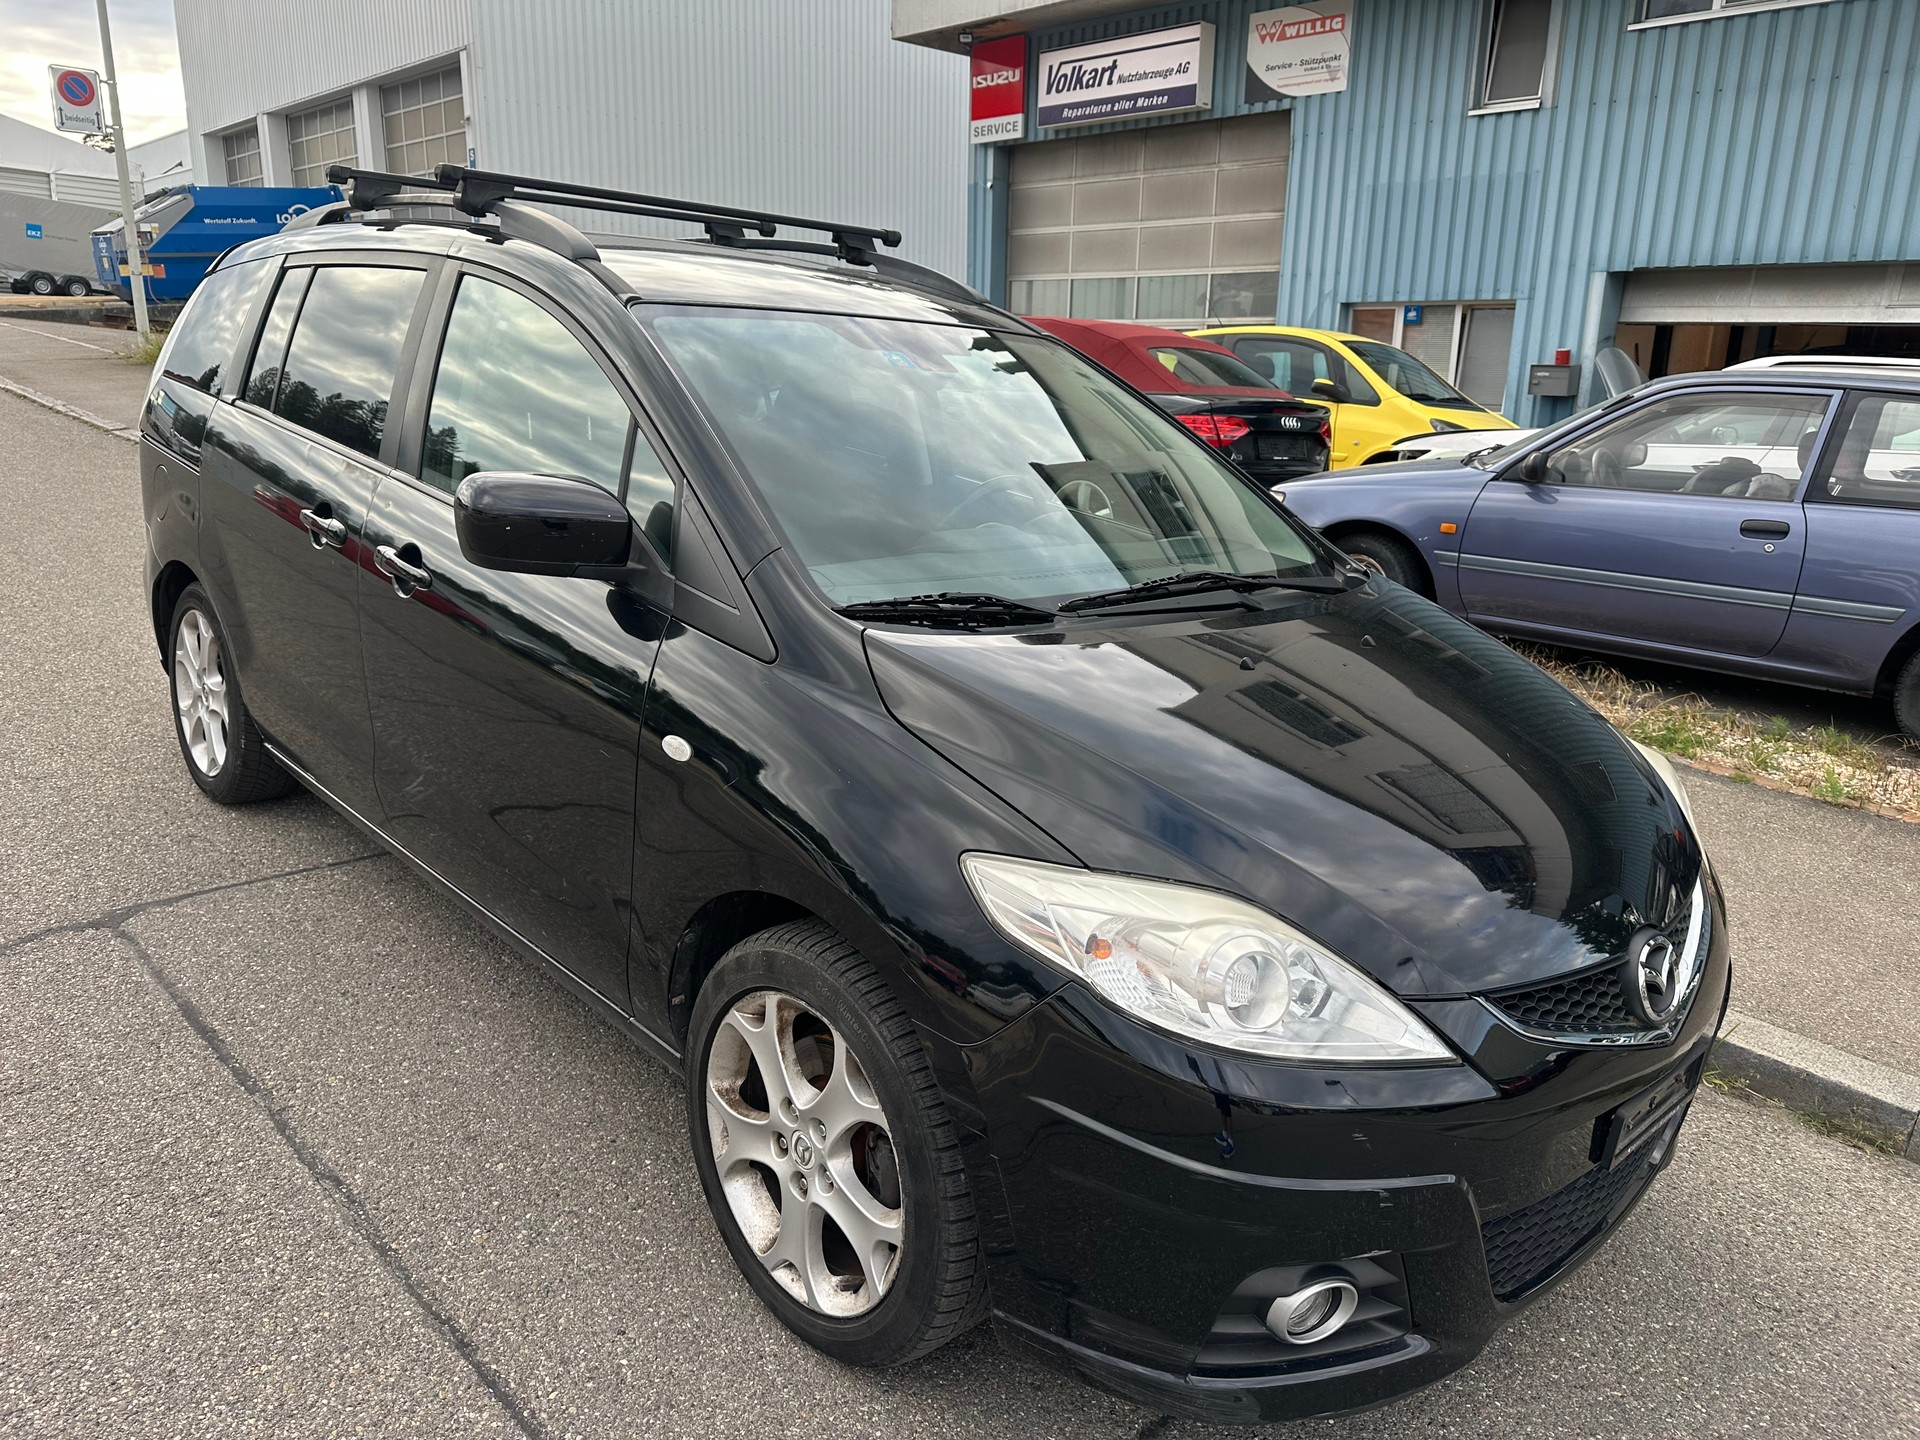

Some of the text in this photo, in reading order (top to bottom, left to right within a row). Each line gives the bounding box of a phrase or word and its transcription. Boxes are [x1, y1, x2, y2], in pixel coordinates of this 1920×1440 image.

[1284, 17, 1342, 38] WILLIG
[1265, 61, 1293, 72] Service
[1299, 54, 1342, 67] Stützpunkt
[972, 68, 1020, 89] ISUZU
[1046, 59, 1191, 95] Volkart Nutzfahrzeuge AG
[1062, 94, 1169, 119] Reparaturen aller Marken
[64, 113, 96, 126] beidseitig
[973, 120, 1019, 138] SERVICE
[27, 229, 42, 237] EKZ
